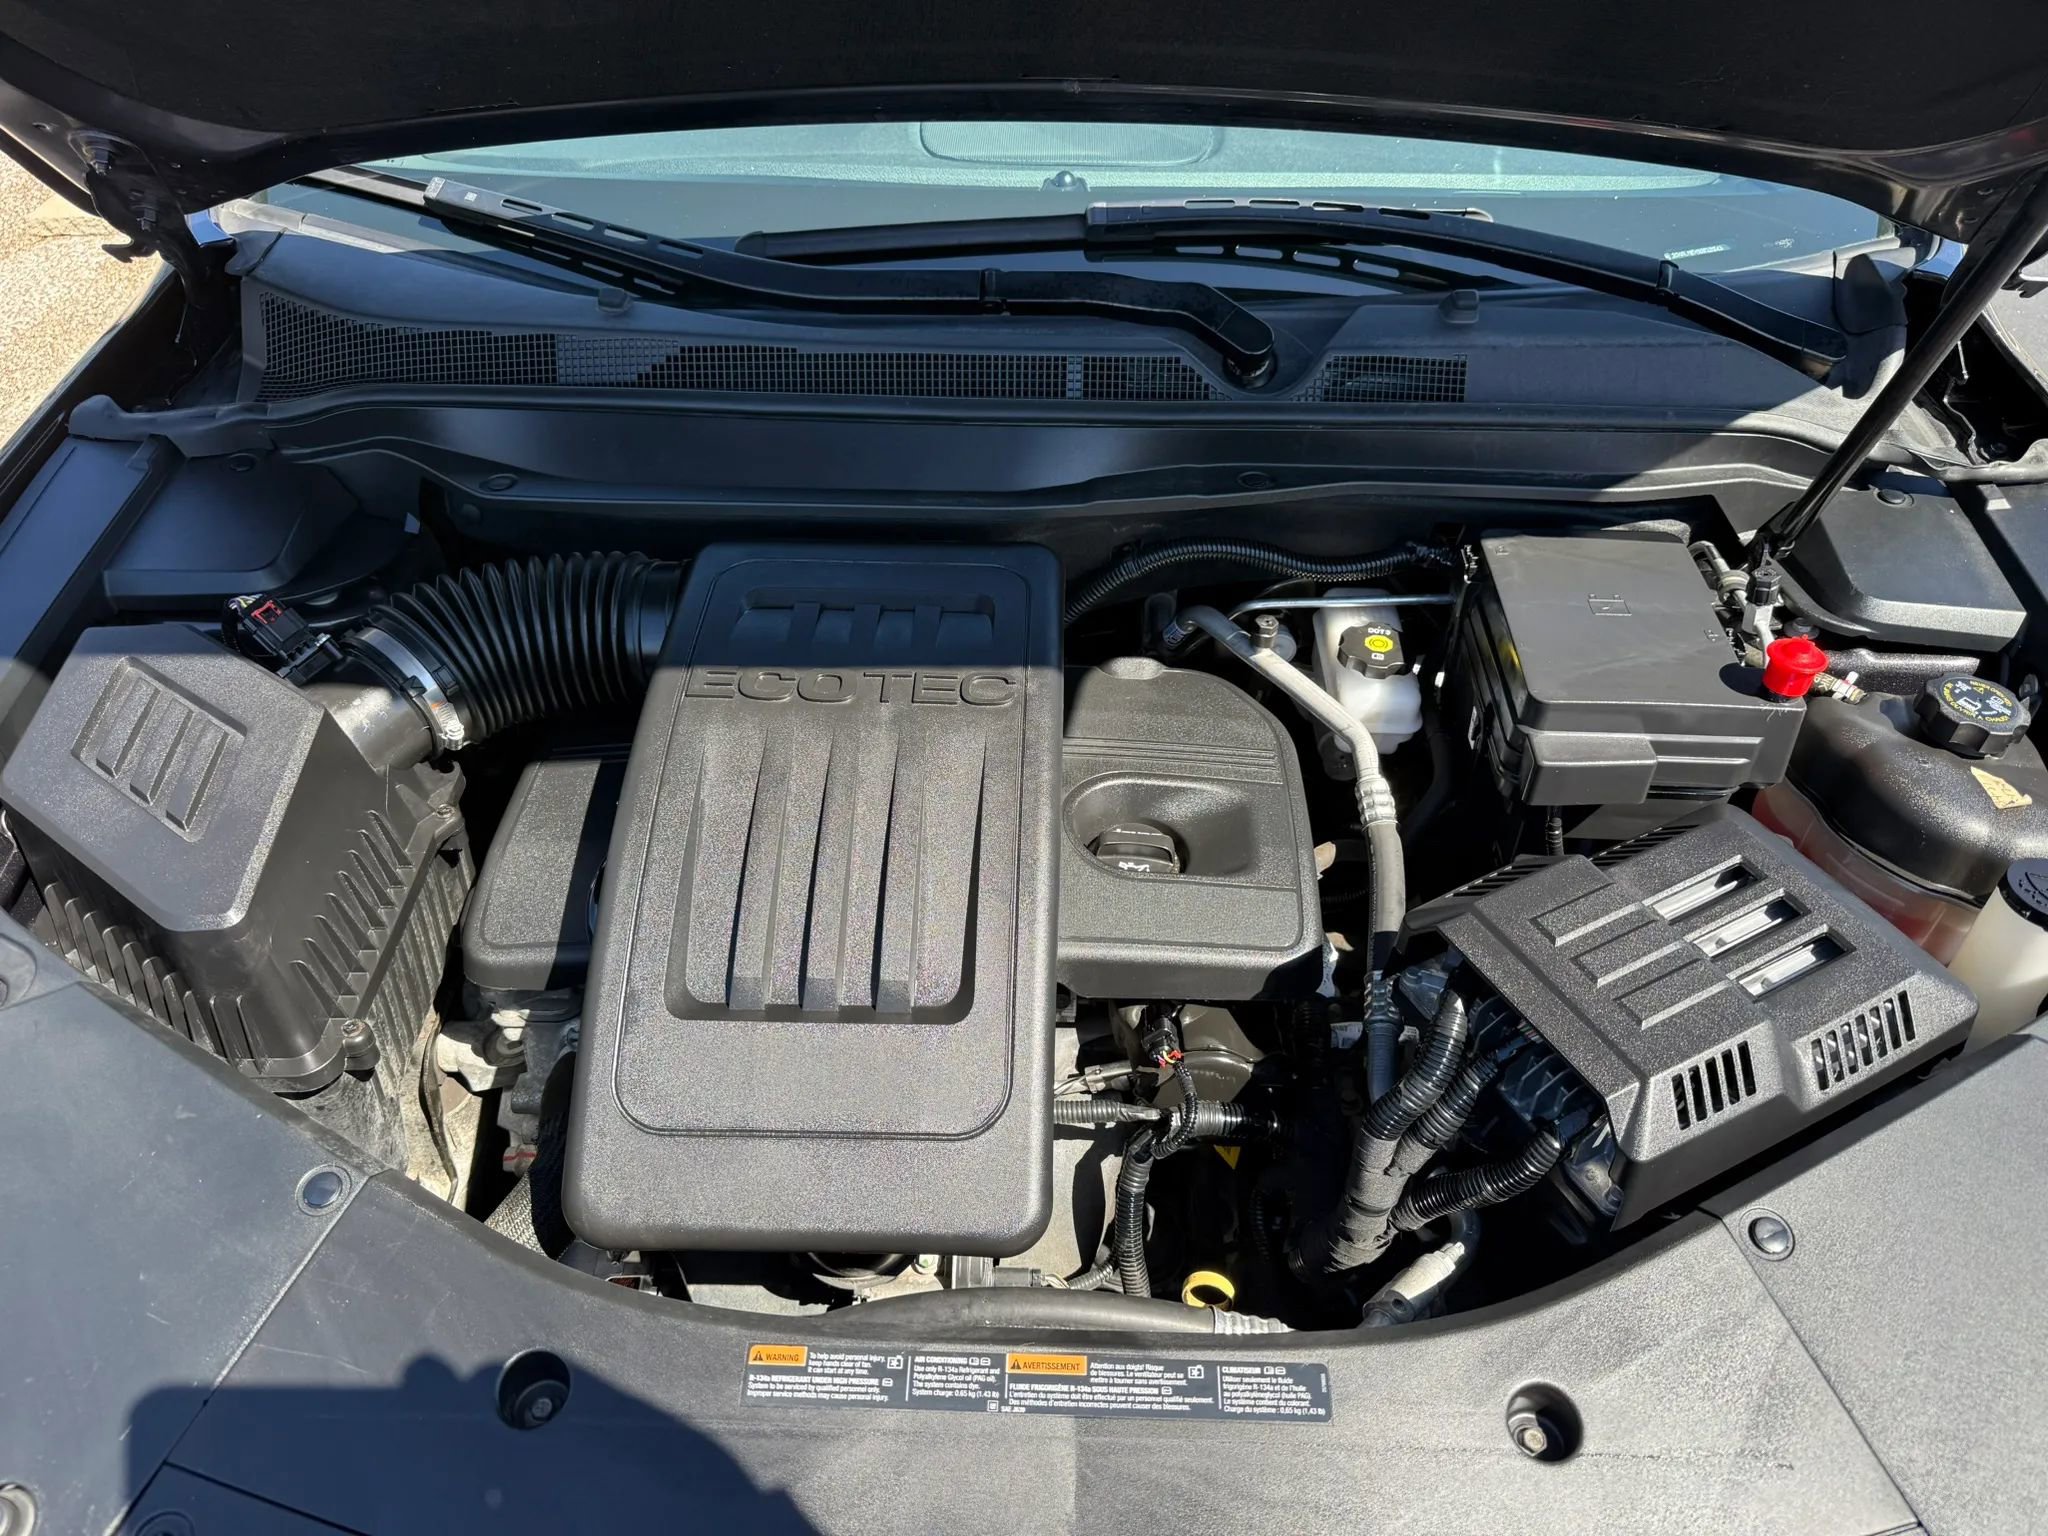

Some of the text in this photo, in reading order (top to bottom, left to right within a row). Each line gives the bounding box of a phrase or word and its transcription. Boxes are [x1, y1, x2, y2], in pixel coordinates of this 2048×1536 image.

[685, 671, 1016, 706] ECOTEC
[766, 1353, 799, 1361] WARNING
[817, 1352, 829, 1360] help
[845, 1354, 868, 1362] personal
[1023, 1361, 1080, 1370] AVERTISSEMENT
